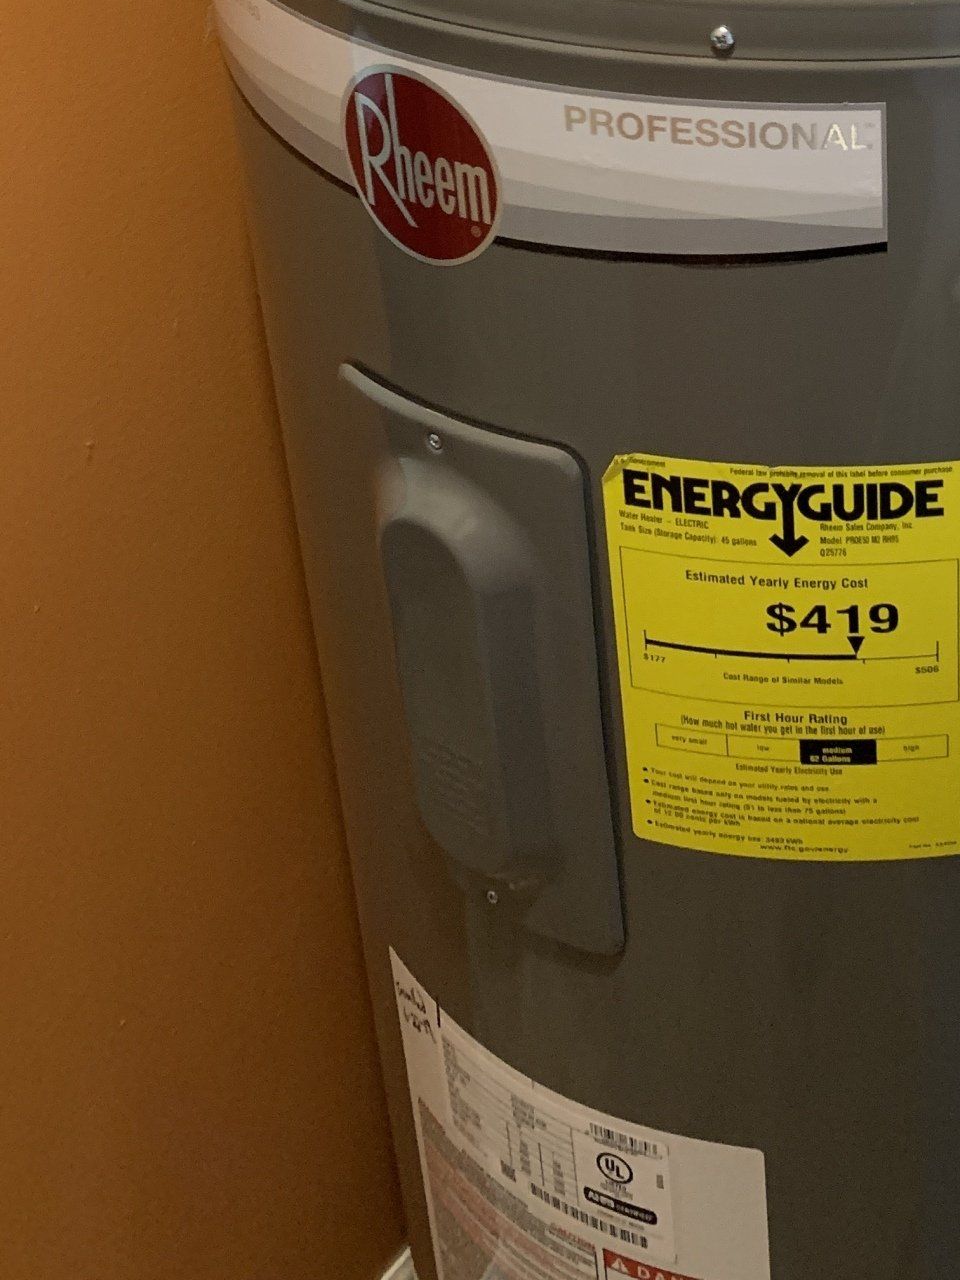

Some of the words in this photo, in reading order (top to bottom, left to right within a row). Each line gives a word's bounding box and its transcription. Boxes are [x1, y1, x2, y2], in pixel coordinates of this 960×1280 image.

[564, 104, 867, 151] PROFESSIONAL
[354, 74, 491, 229] Rheem
[836, 470, 849, 478] this
[850, 470, 867, 478] label
[868, 469, 889, 477] before
[622, 468, 945, 523] ENERGYGUIDE
[618, 509, 639, 521] Water
[675, 517, 709, 529] ELECTRIC
[819, 523, 843, 532] Rheem
[845, 522, 864, 531] Sales
[620, 521, 636, 533] Tank
[638, 523, 652, 535] Size
[653, 526, 683, 540] (Storage
[731, 536, 757, 547] gallons
[819, 536, 842, 545] Model
[685, 570, 746, 586] Estimated
[750, 575, 789, 590] Yearly
[794, 577, 837, 590] Energy
[841, 577, 869, 589] Cost
[766, 602, 900, 638] $419
[643, 652, 666, 664] $177
[723, 672, 741, 681] Cost
[742, 673, 770, 684] Range
[771, 675, 780, 683] of
[782, 676, 811, 685] Similar
[813, 677, 844, 685] Models
[680, 714, 700, 726] (How
[701, 719, 723, 730] much
[725, 721, 738, 731] hot
[740, 722, 762, 733] water
[763, 725, 778, 736] you
[780, 725, 793, 736] get
[805, 726, 818, 735] the
[820, 725, 836, 735] first
[838, 726, 857, 735] hour
[858, 726, 867, 735] of
[868, 725, 886, 735] use)
[744, 710, 771, 723] First
[775, 712, 804, 724] Hour
[808, 713, 849, 726] Rating
[688, 737, 708, 745] small
[822, 746, 853, 754] medium
[821, 755, 851, 763] Gallons
[735, 763, 769, 773] Estimated
[770, 765, 792, 775] Yearly
[829, 767, 843, 775] Use
[604, 1157, 625, 1180] UL
